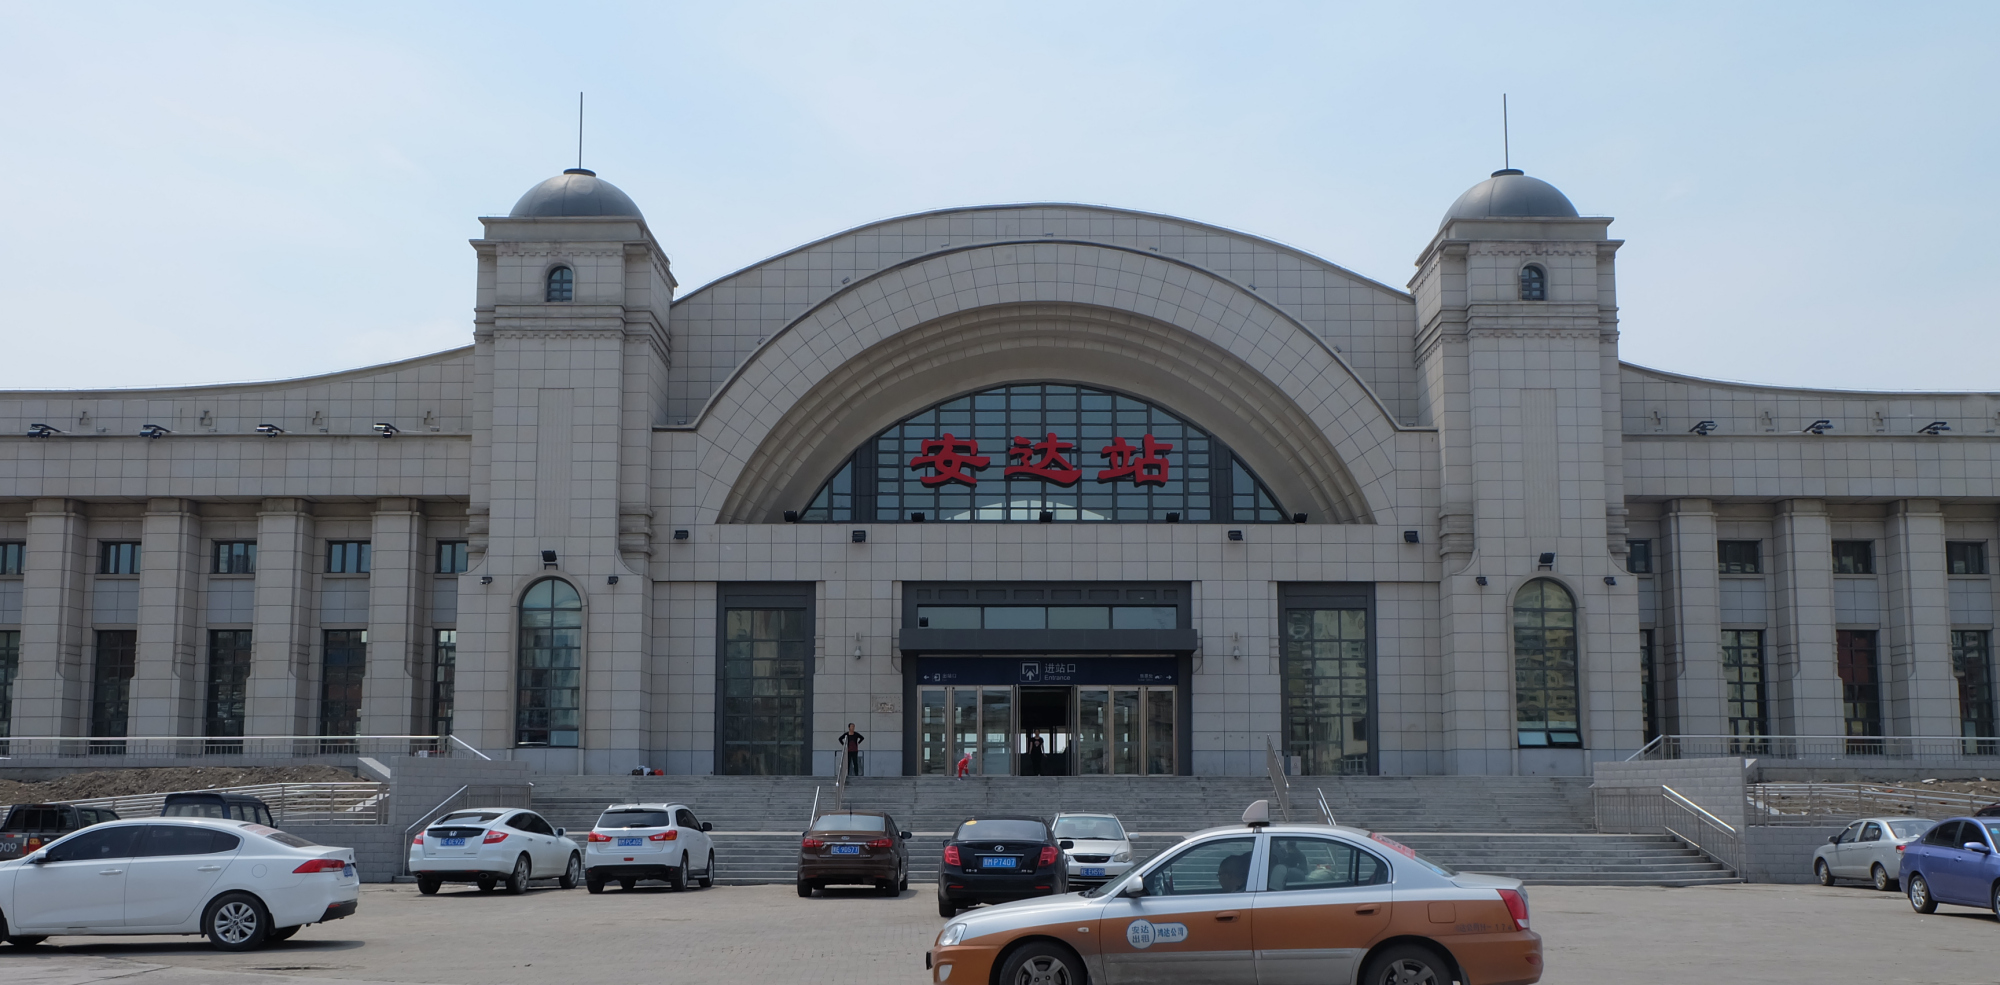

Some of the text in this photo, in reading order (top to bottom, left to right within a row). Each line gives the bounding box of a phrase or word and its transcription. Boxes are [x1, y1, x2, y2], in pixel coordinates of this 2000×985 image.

[910, 433, 1173, 488] 安达站
[1044, 663, 1076, 674] 进站口
[1131, 925, 1149, 934] 安达
[1157, 927, 1184, 938] 鸿达公司
[1132, 934, 1150, 943] 出租
